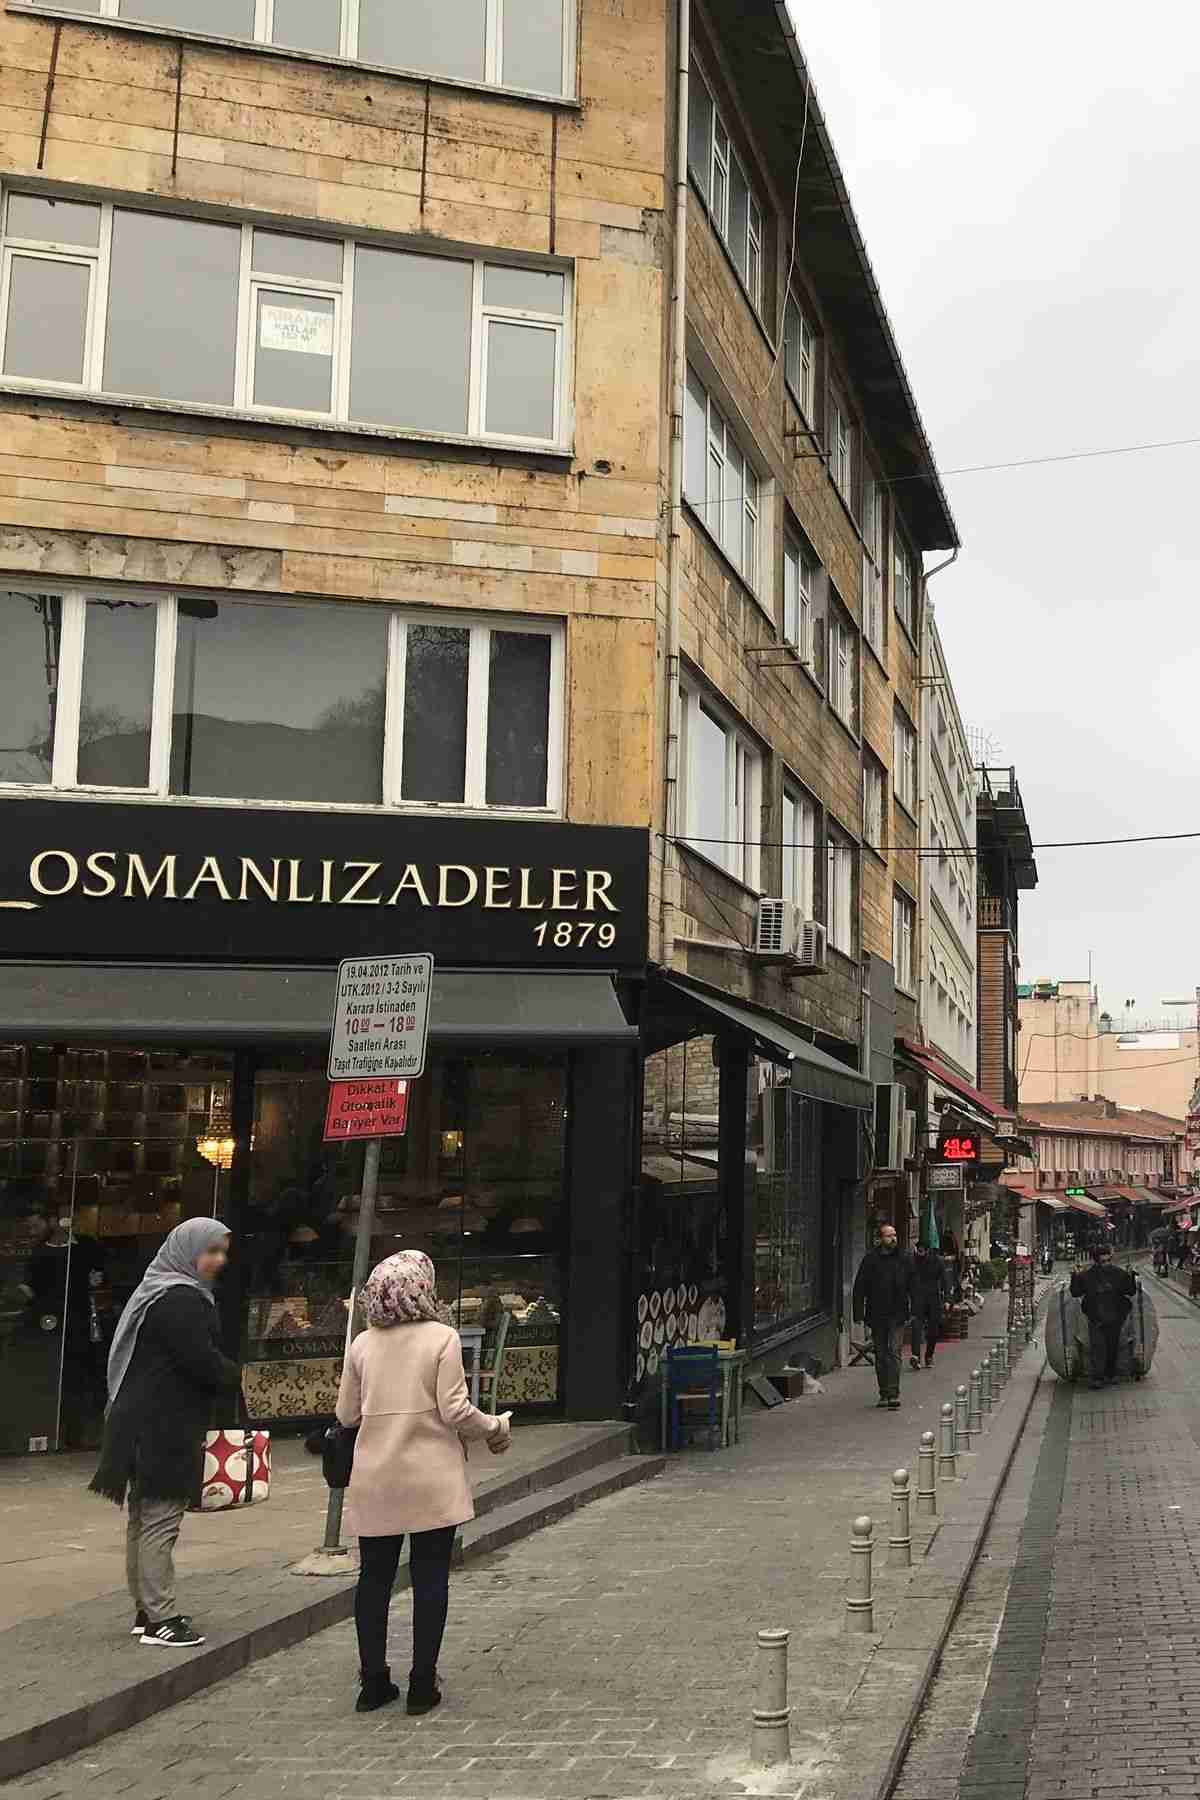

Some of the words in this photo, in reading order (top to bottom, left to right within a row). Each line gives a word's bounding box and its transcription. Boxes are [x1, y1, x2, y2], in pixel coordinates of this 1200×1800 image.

[29, 850, 622, 912] OSMANLIZADELER
[533, 920, 617, 948] 1879
[346, 964, 389, 978] 19.04.2012
[391, 962, 412, 976] Tarih
[414, 964, 424, 974] ve
[346, 1002, 374, 1015] Karara
[348, 1039, 381, 1052] Saatleri
